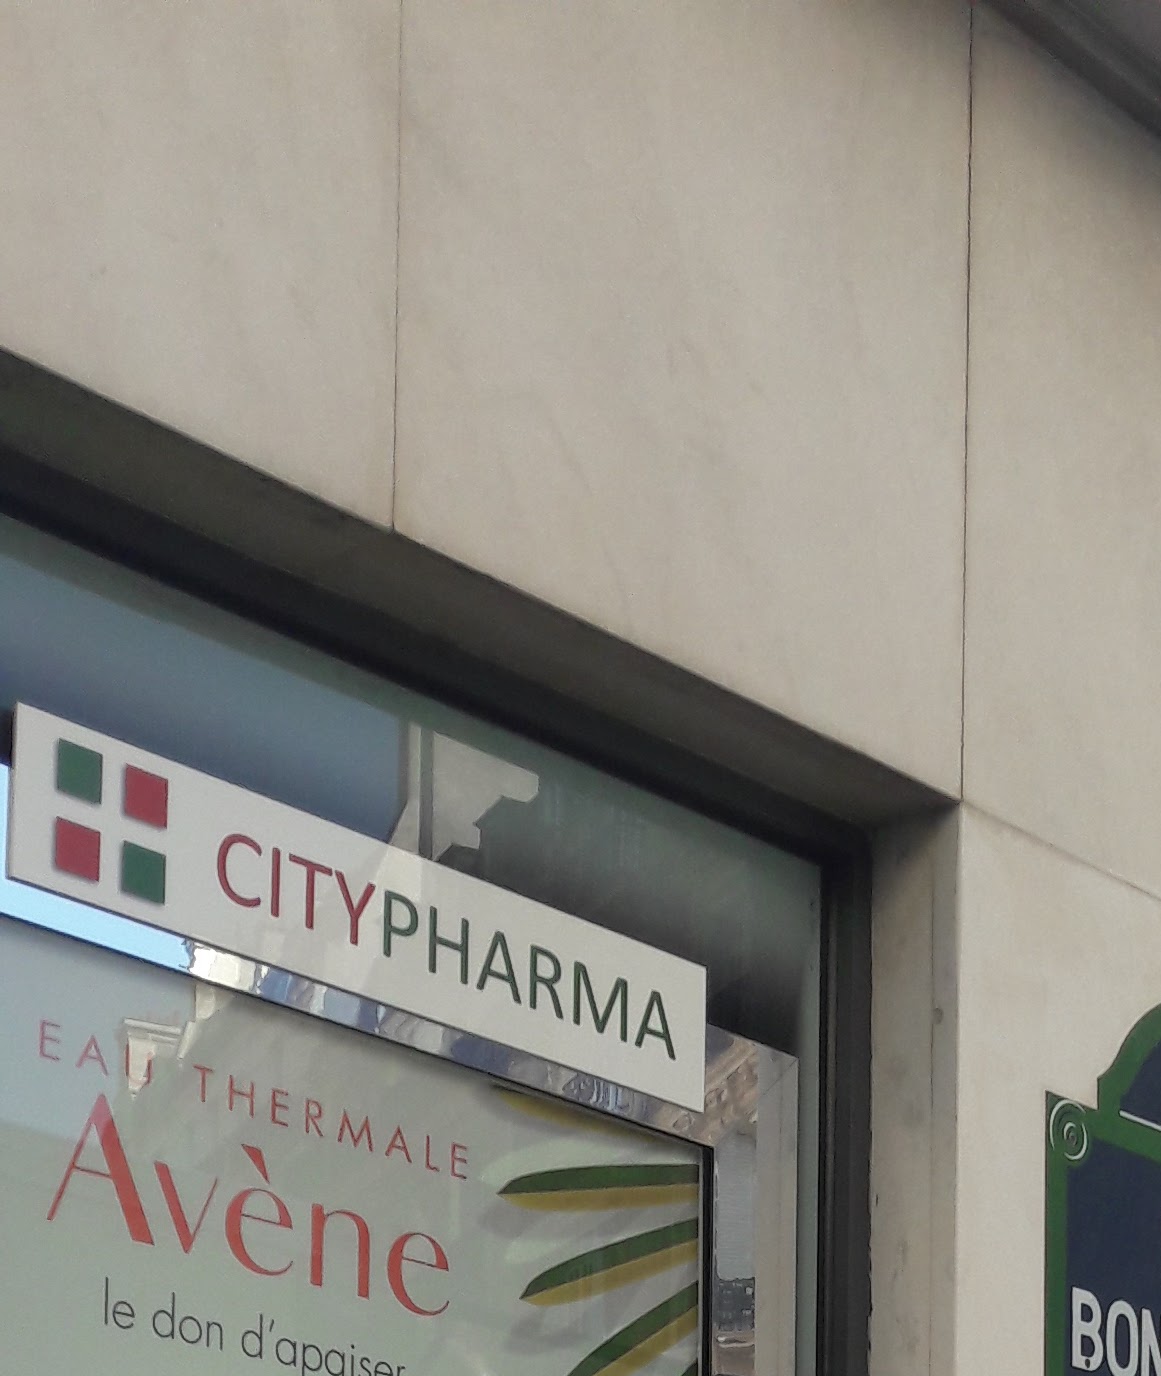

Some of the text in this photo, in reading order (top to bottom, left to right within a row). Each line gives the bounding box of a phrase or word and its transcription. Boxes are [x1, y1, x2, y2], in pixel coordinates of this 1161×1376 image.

[217, 833, 677, 1061] CITYPHARMA
[38, 1020, 472, 1181] EAU THERMALE
[47, 1093, 452, 1317] Avène
[103, 1277, 136, 1329] le
[152, 1293, 225, 1352] don
